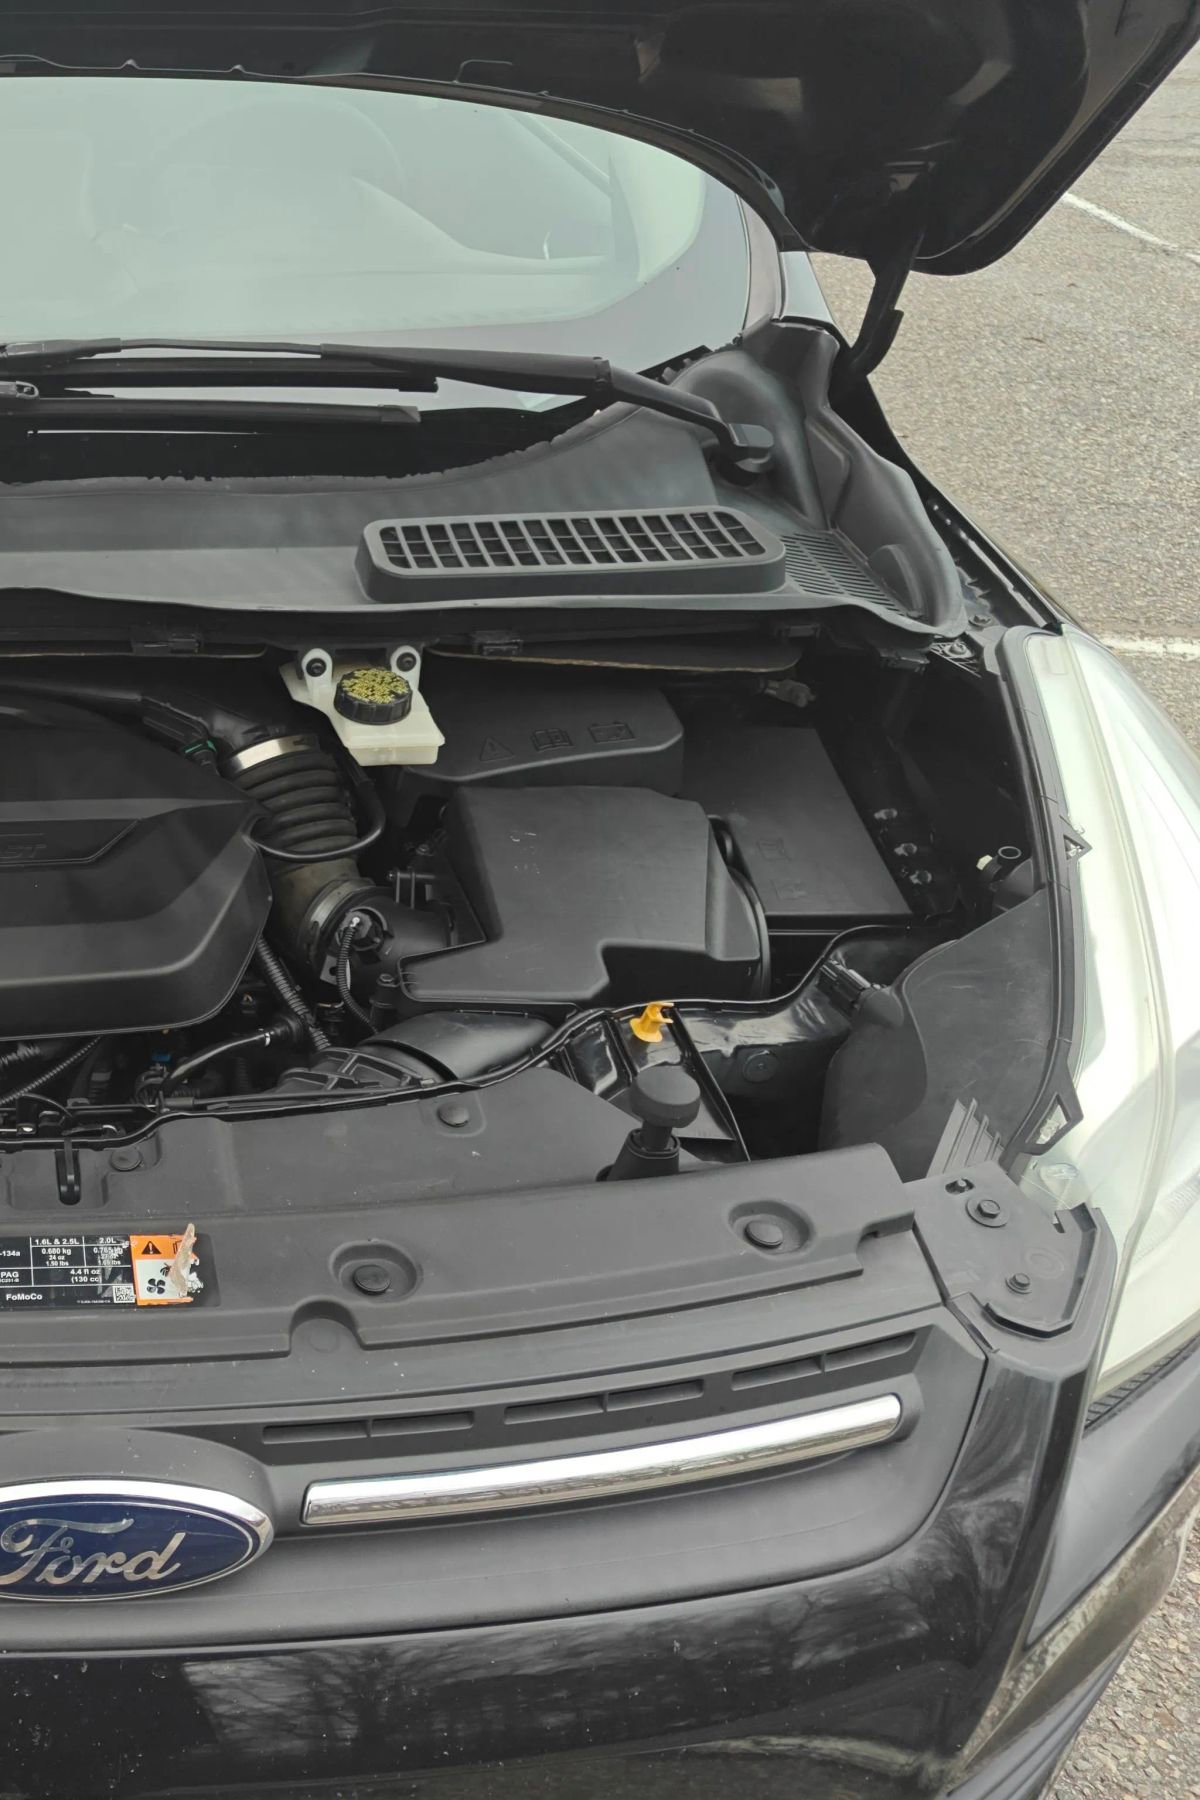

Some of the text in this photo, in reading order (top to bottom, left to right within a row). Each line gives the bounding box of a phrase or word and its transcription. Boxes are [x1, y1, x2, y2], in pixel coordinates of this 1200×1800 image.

[34, 1238, 52, 1246] 1.6L
[62, 1248, 72, 1256] kg
[71, 1276, 88, 1284] (130
[6, 1293, 43, 1301] FoMoCo
